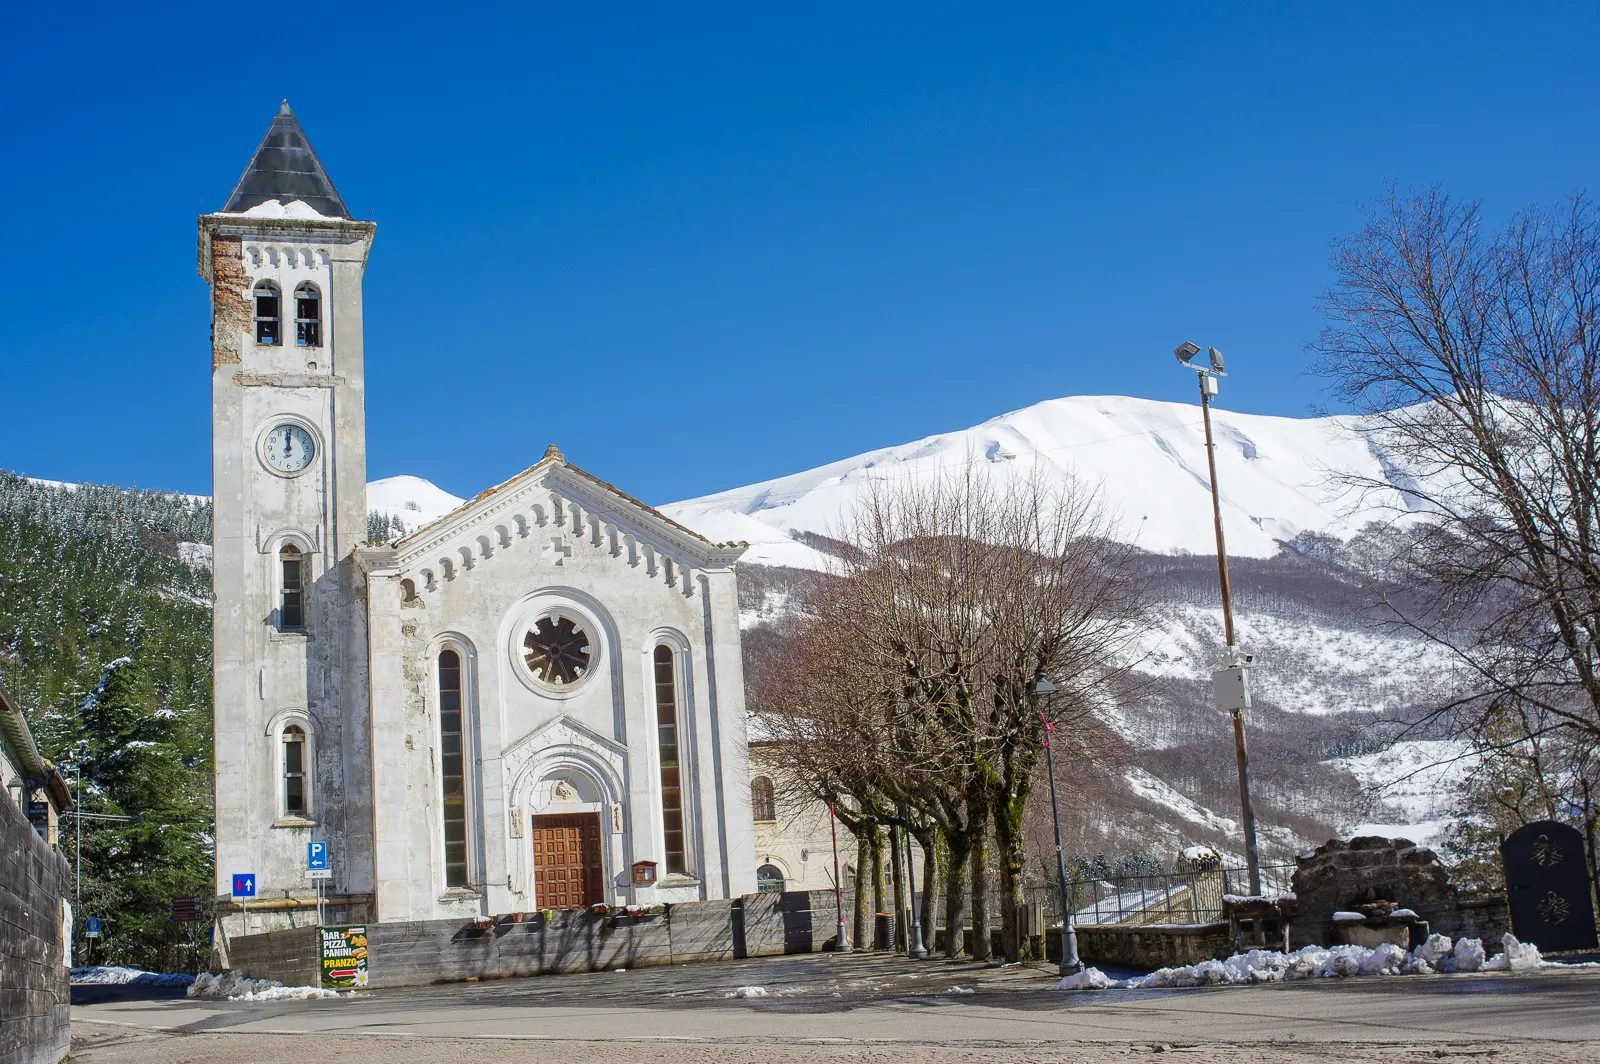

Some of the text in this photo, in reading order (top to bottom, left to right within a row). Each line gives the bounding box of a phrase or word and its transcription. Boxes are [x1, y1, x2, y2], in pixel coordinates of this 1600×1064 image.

[312, 844, 322, 856] P
[323, 931, 340, 941] BAR
[323, 939, 347, 949] PIZZA
[323, 947, 352, 958] PANINI
[323, 958, 357, 969] PRANZO
